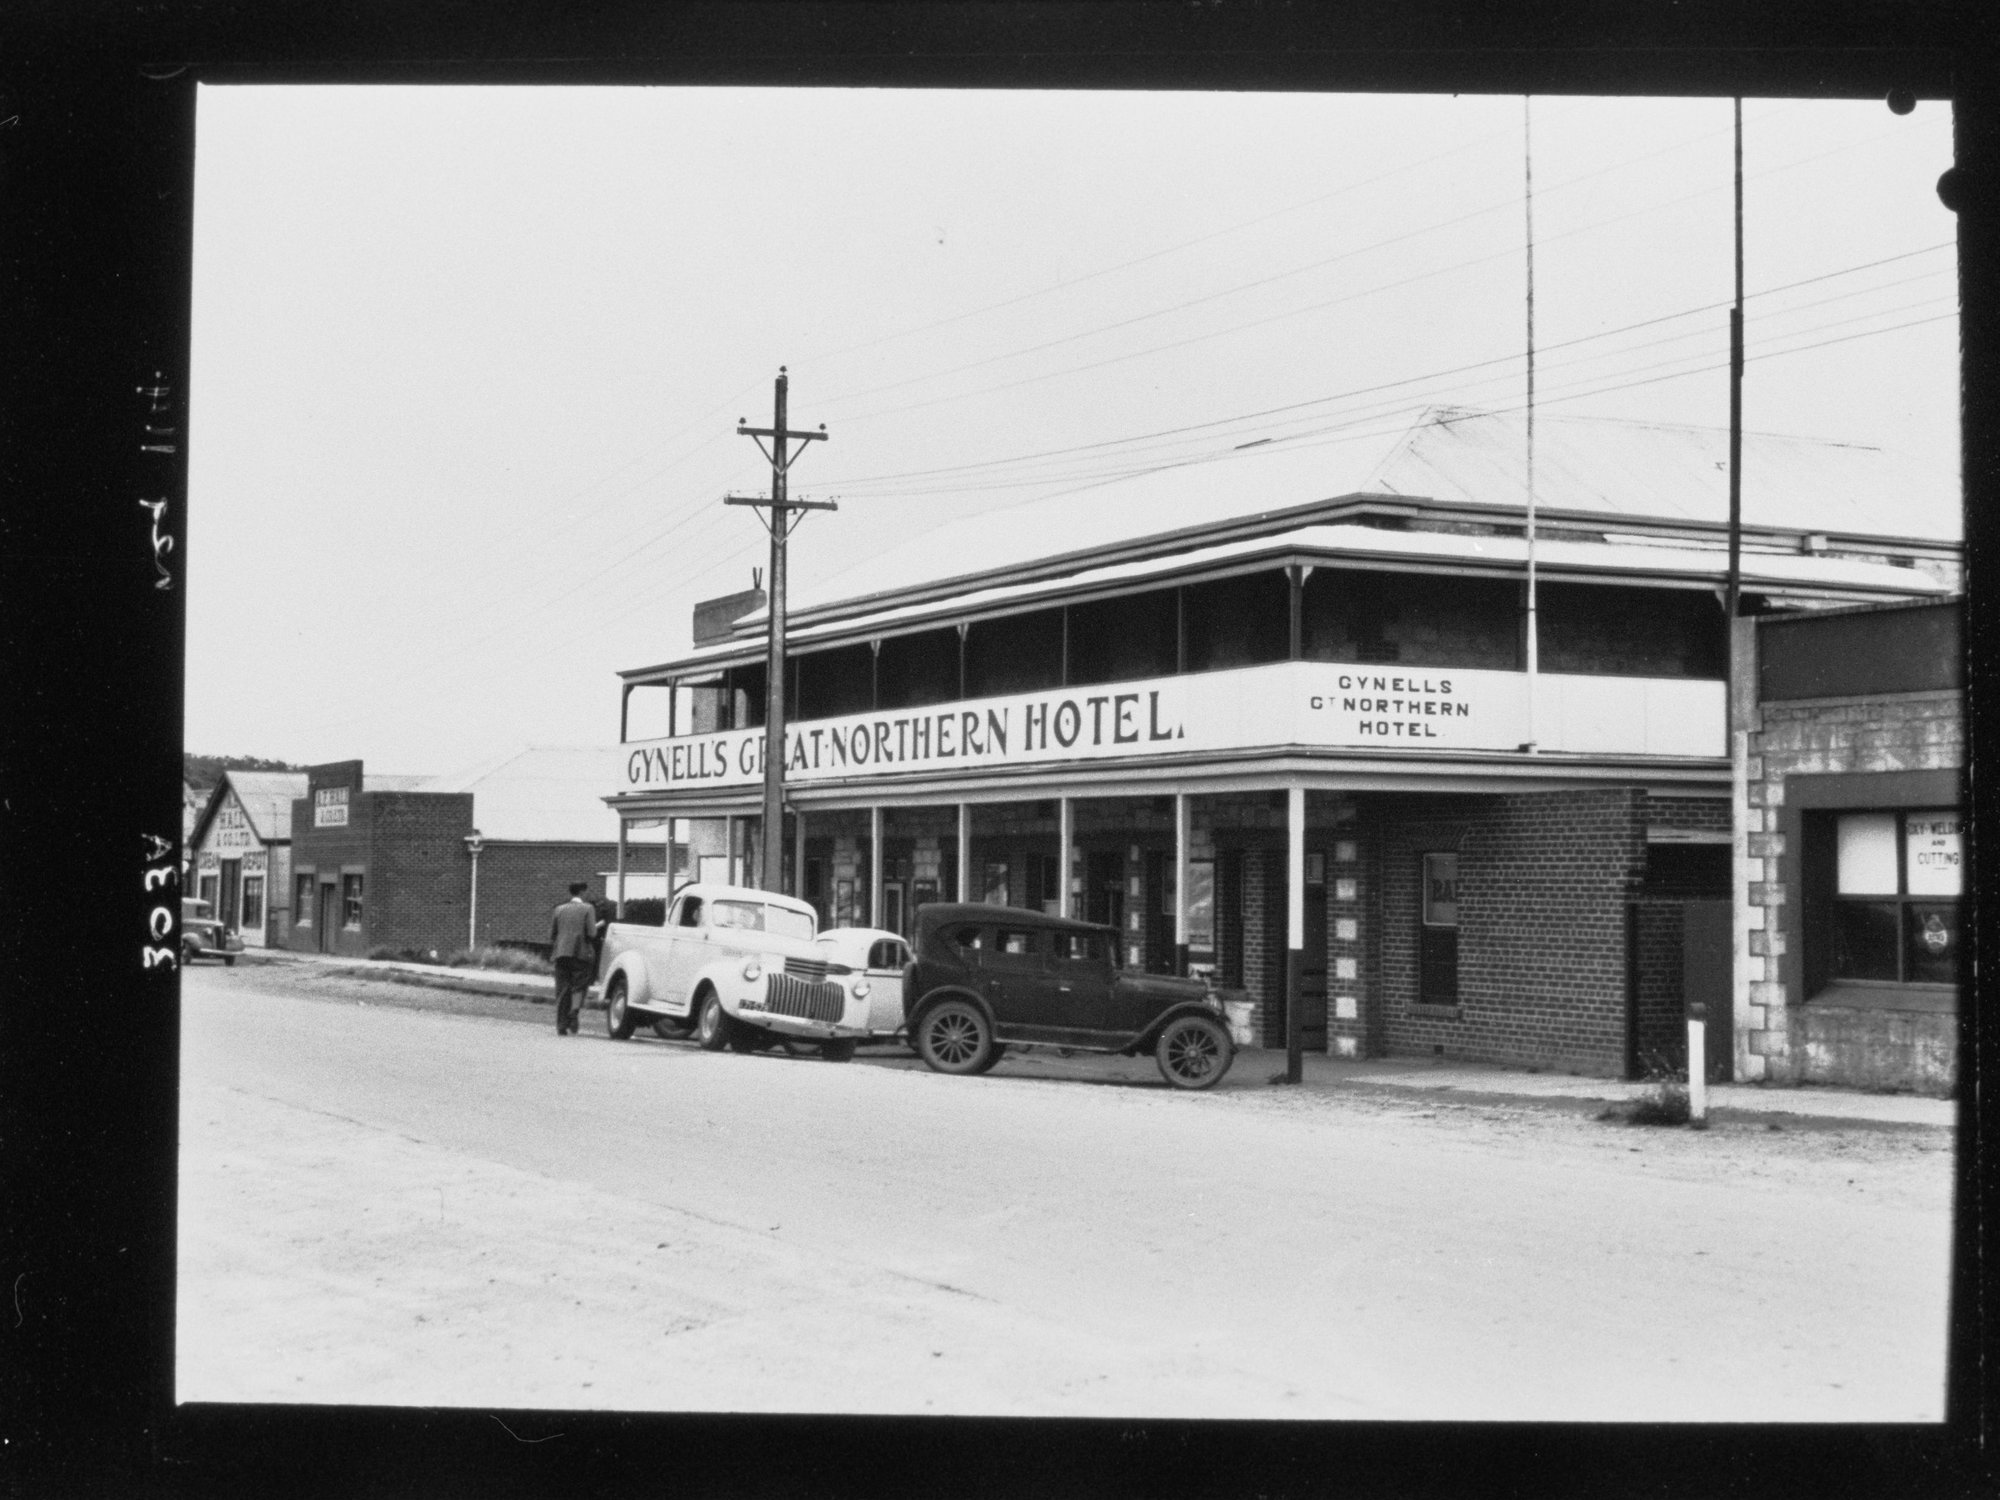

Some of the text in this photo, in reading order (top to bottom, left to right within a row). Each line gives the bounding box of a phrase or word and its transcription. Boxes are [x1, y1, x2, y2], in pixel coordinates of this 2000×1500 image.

[1338, 675, 1453, 694] GYNELLS
[1343, 697, 1469, 717] NORTHERN
[830, 706, 1009, 768] NORTHERN
[1359, 720, 1437, 737] HOTEL
[1917, 851, 1959, 865] CUTTING
